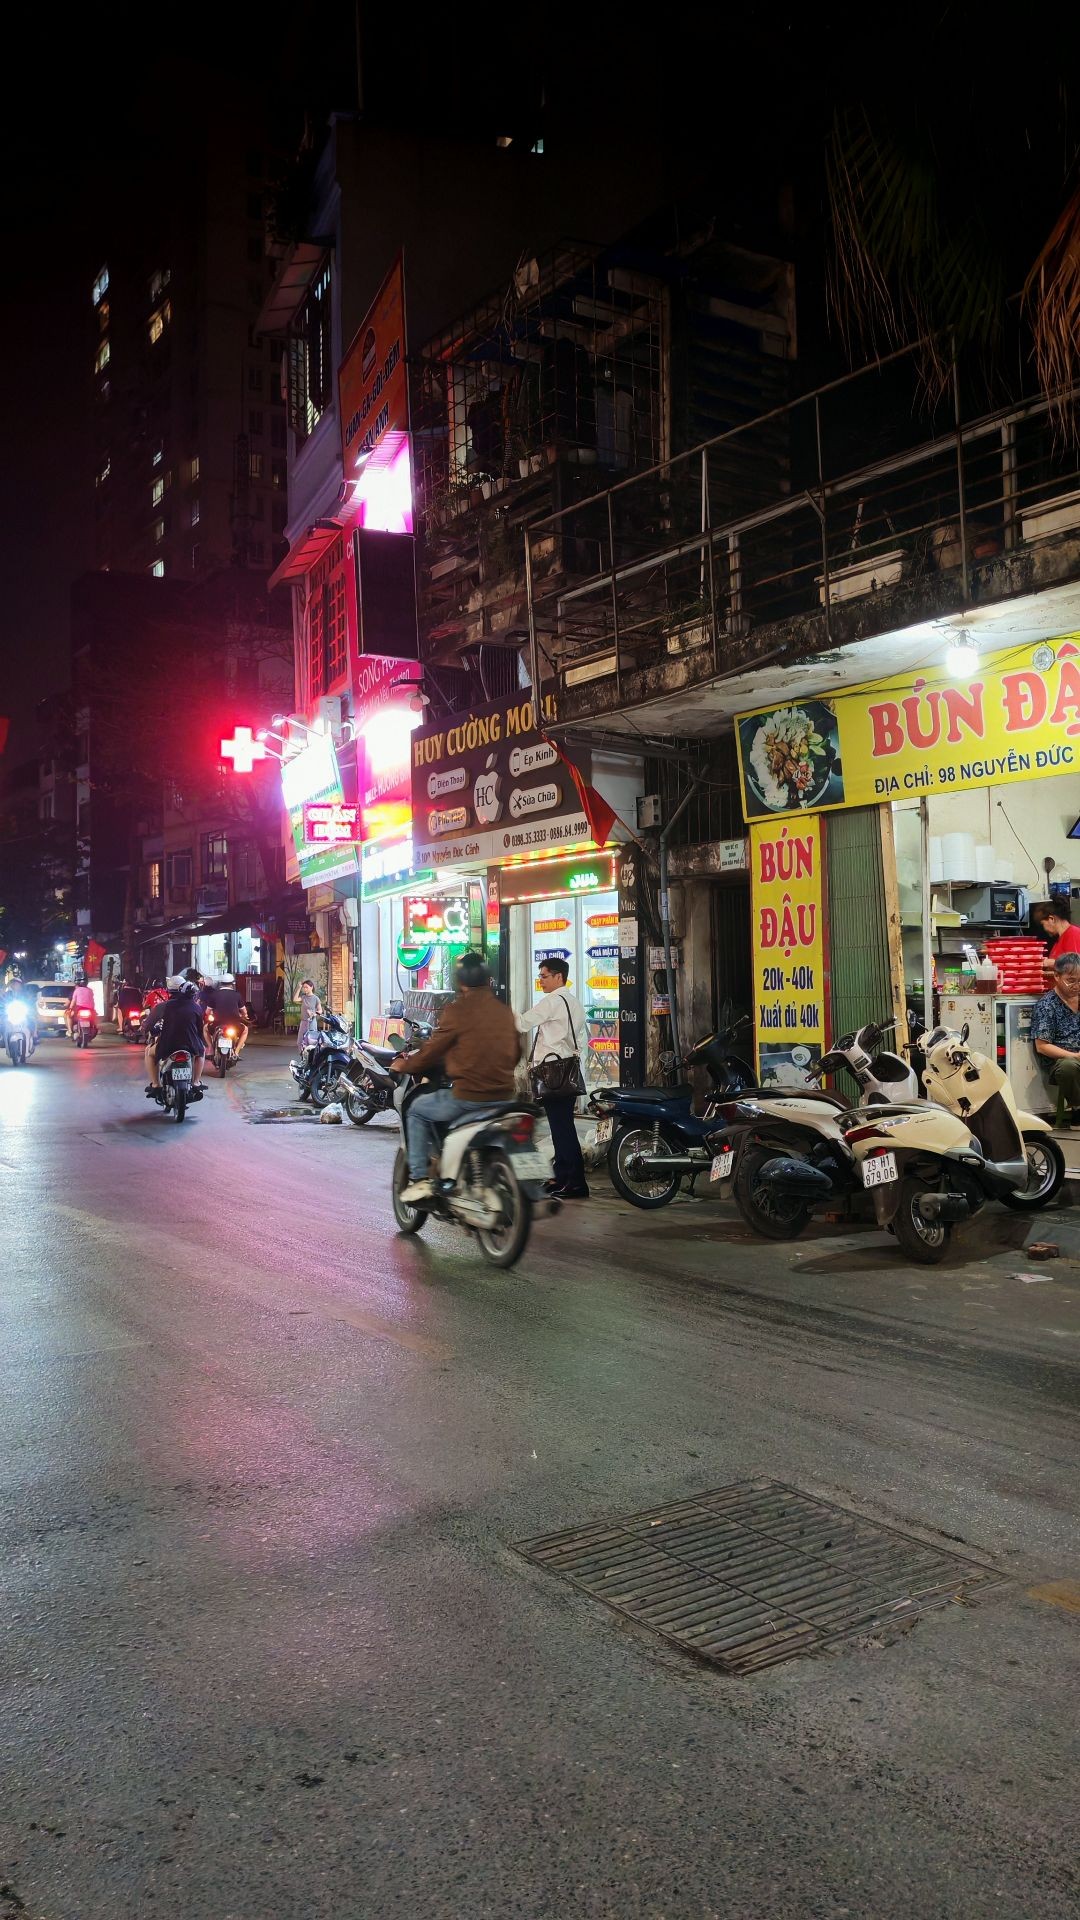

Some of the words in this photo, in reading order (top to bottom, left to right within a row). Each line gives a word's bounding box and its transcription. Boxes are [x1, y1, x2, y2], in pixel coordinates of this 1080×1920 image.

[868, 678, 984, 757] BÚN
[414, 733, 444, 767] HUY
[446, 713, 500, 756] CƯỜNG
[524, 751, 534, 765] Ép
[875, 777, 899, 796] ĐỊA
[904, 764, 934, 789] CHỈ:
[938, 766, 955, 784] 98
[960, 748, 1031, 780] NGUYỄN
[1036, 744, 1074, 768] ĐỨC
[475, 784, 494, 807] HC
[537, 789, 556, 803] Chữa
[759, 827, 814, 883] BÚN
[759, 892, 816, 958] ĐẬU
[760, 999, 783, 1028] Xuất
[784, 1000, 797, 1028] đủ
[800, 1003, 819, 1028] 40k
[865, 1166, 895, 1186] 879.06
